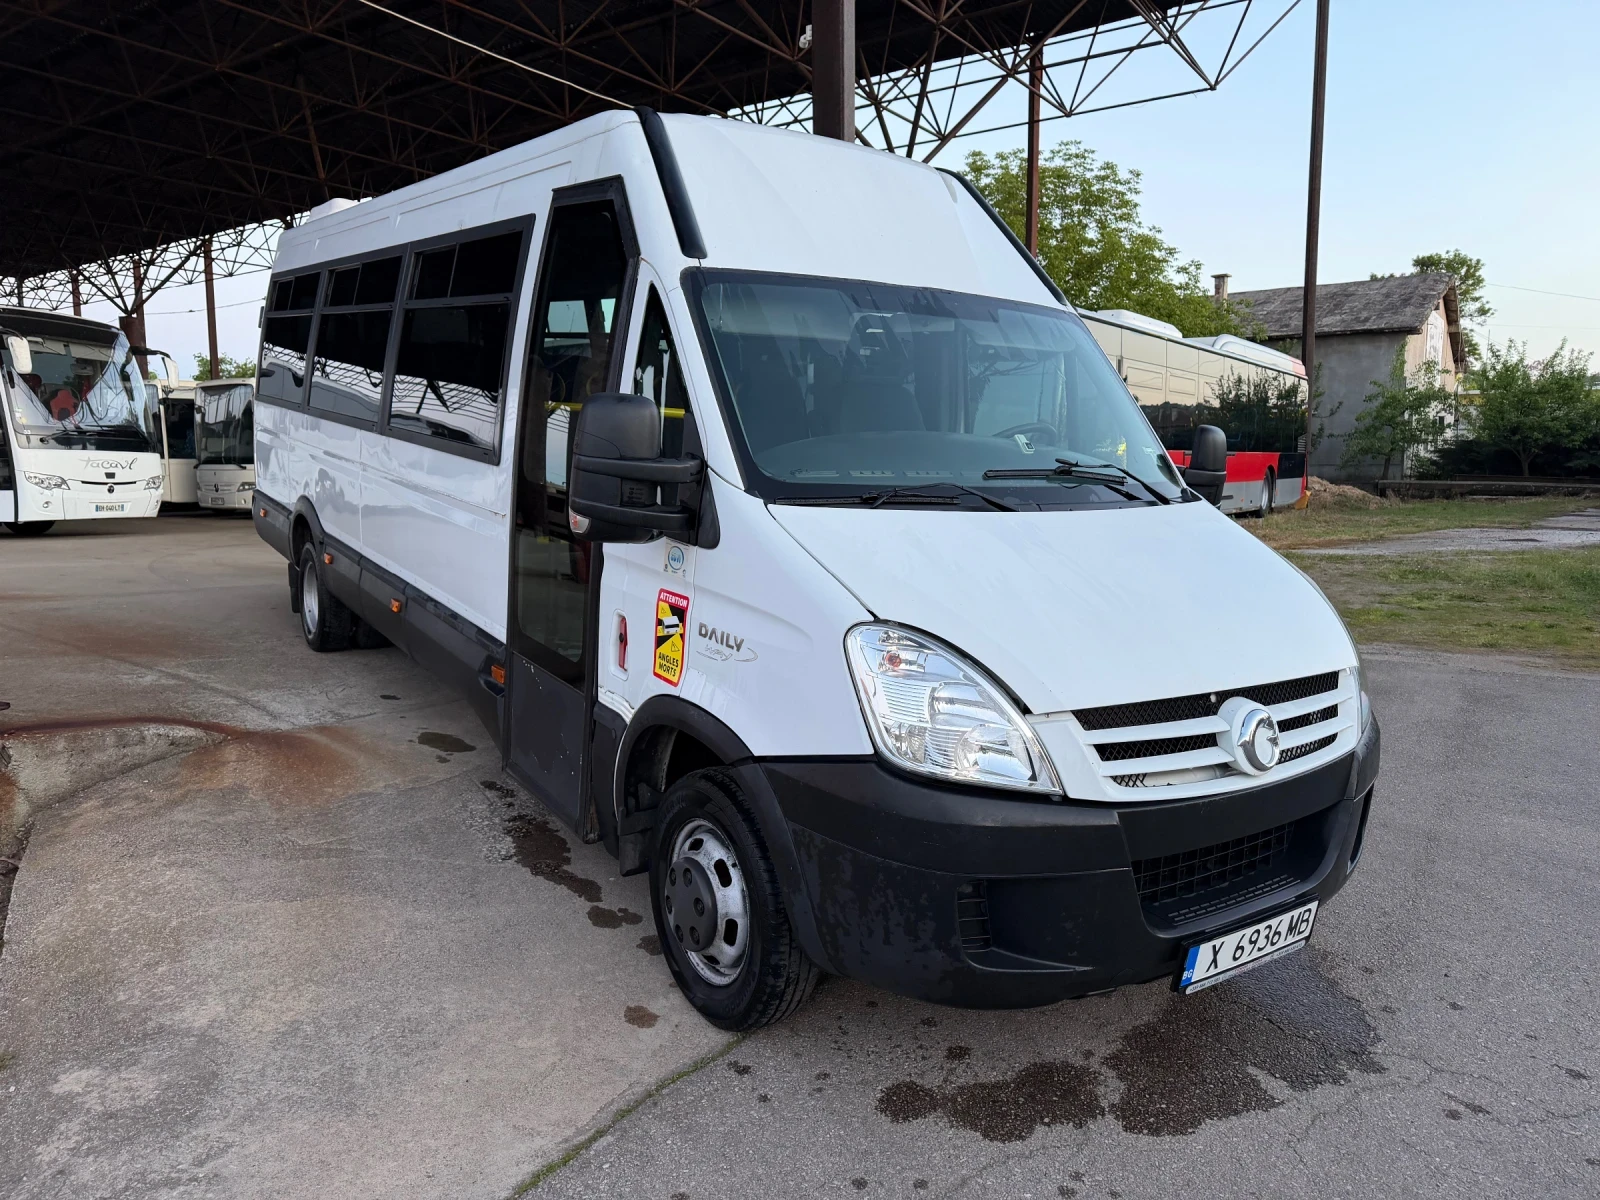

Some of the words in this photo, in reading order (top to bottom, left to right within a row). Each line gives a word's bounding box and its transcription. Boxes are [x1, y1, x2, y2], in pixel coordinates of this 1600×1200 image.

[659, 591, 688, 608] ATTENTION
[698, 621, 745, 652] DAILY
[658, 651, 679, 668] ANGLES
[658, 661, 677, 677] MORTS
[1205, 941, 1226, 974] X
[1232, 918, 1284, 961] 6936
[1284, 907, 1312, 941] MB
[1182, 969, 1194, 980] BG
